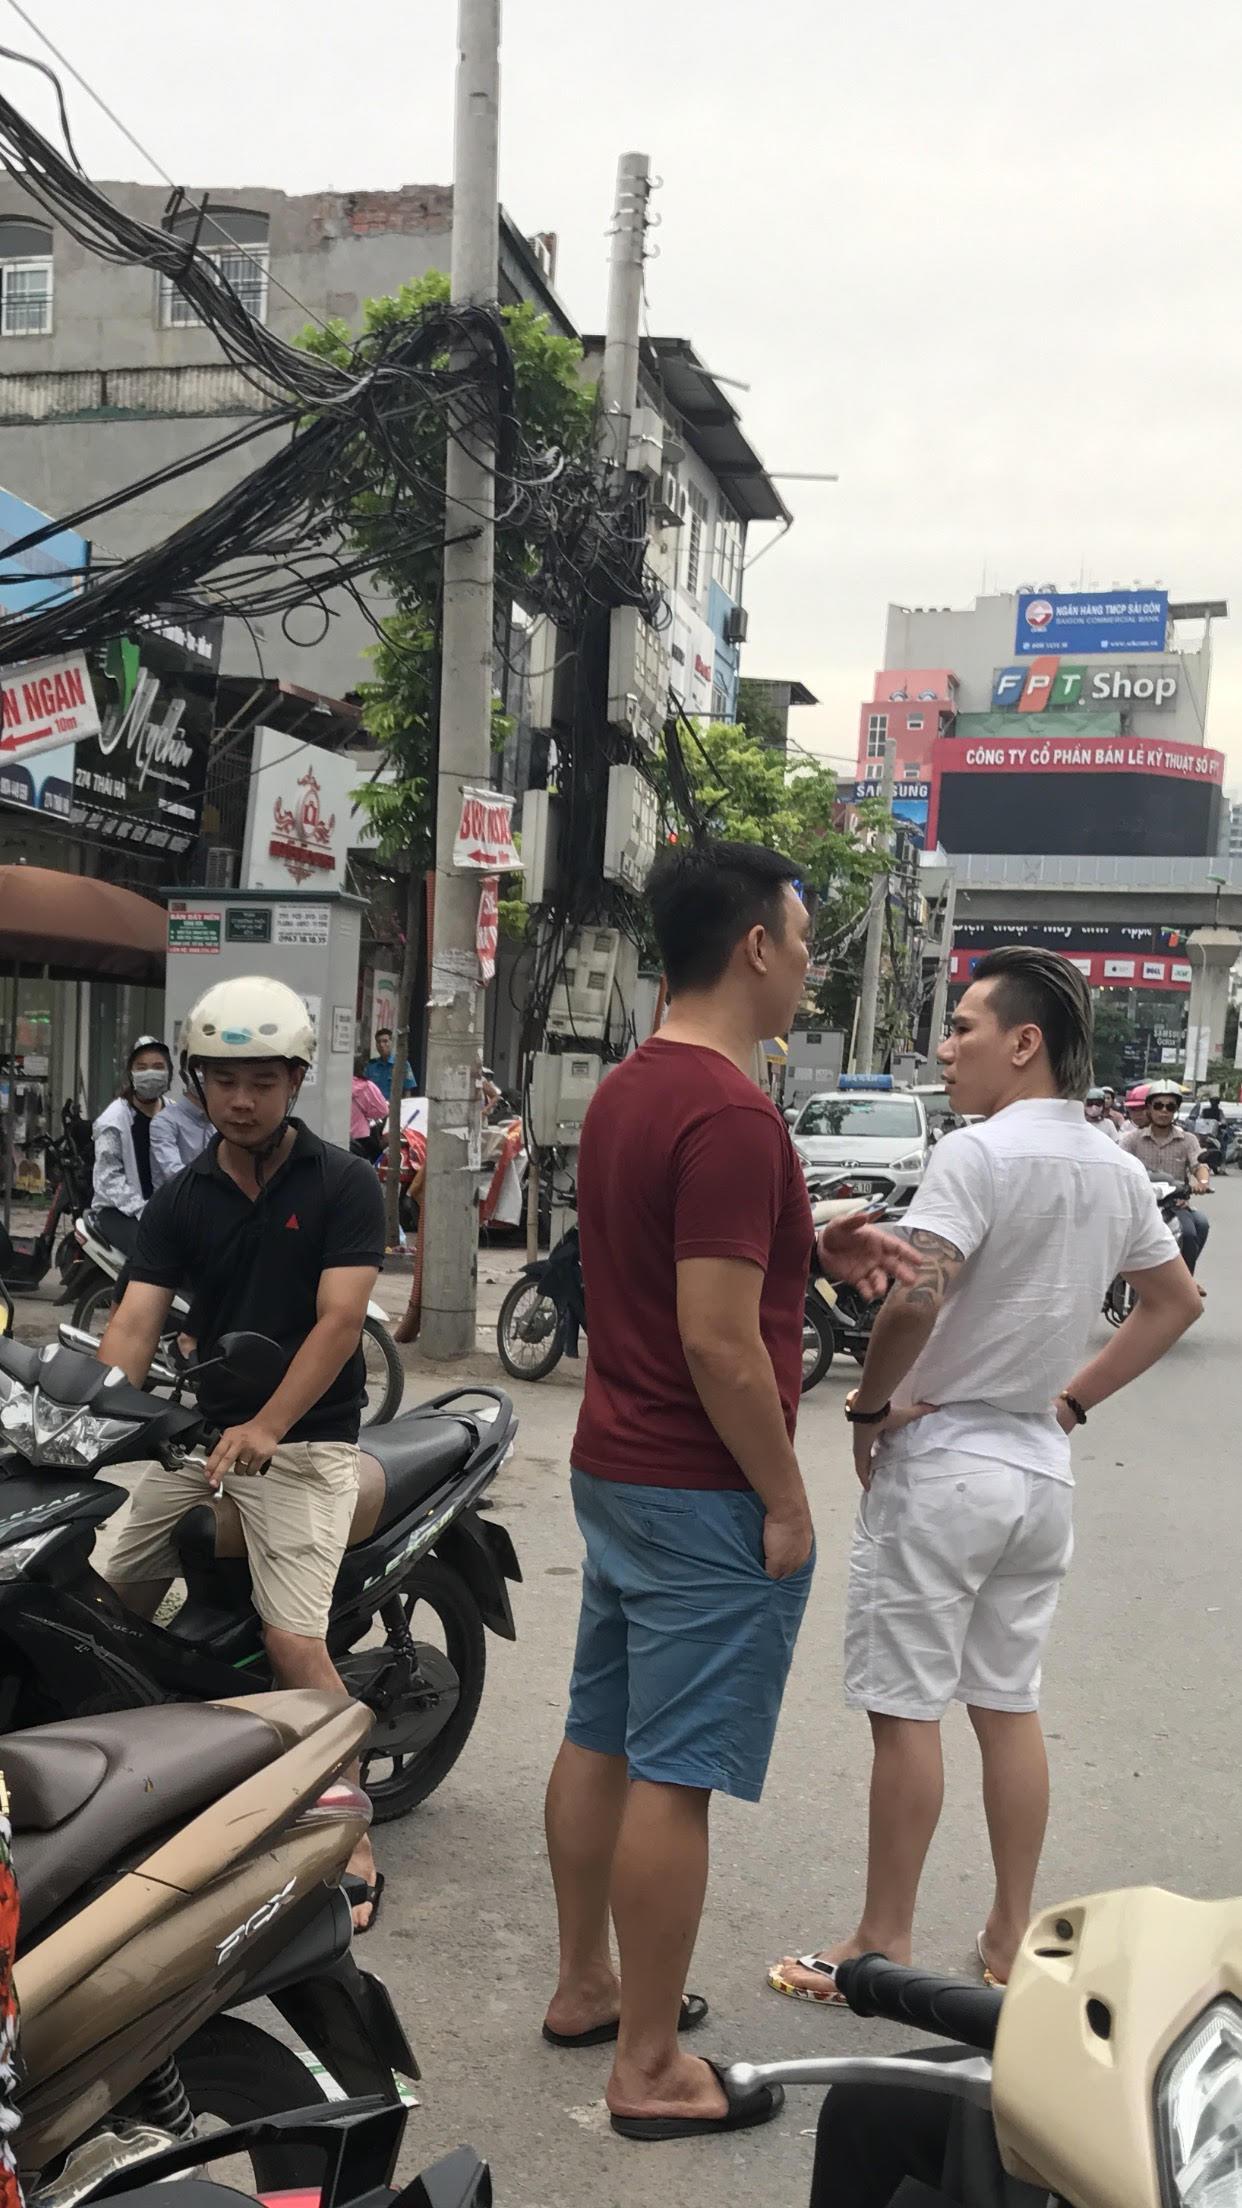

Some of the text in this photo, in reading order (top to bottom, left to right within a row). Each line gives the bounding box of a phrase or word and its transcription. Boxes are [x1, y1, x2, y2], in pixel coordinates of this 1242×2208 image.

[1080, 603, 1104, 616] HÀNG
[1143, 601, 1161, 614] GÒN
[22, 668, 86, 721] NGAN
[1091, 671, 1177, 706] Shop
[966, 746, 1005, 765] CÔNG
[1008, 749, 1027, 765] TY
[1030, 741, 1051, 765] CỔ
[1053, 743, 1093, 765] PHẦN
[1095, 744, 1124, 764] BÁN
[1128, 743, 1144, 765] LẺ
[856, 784, 929, 798] SASUNG
